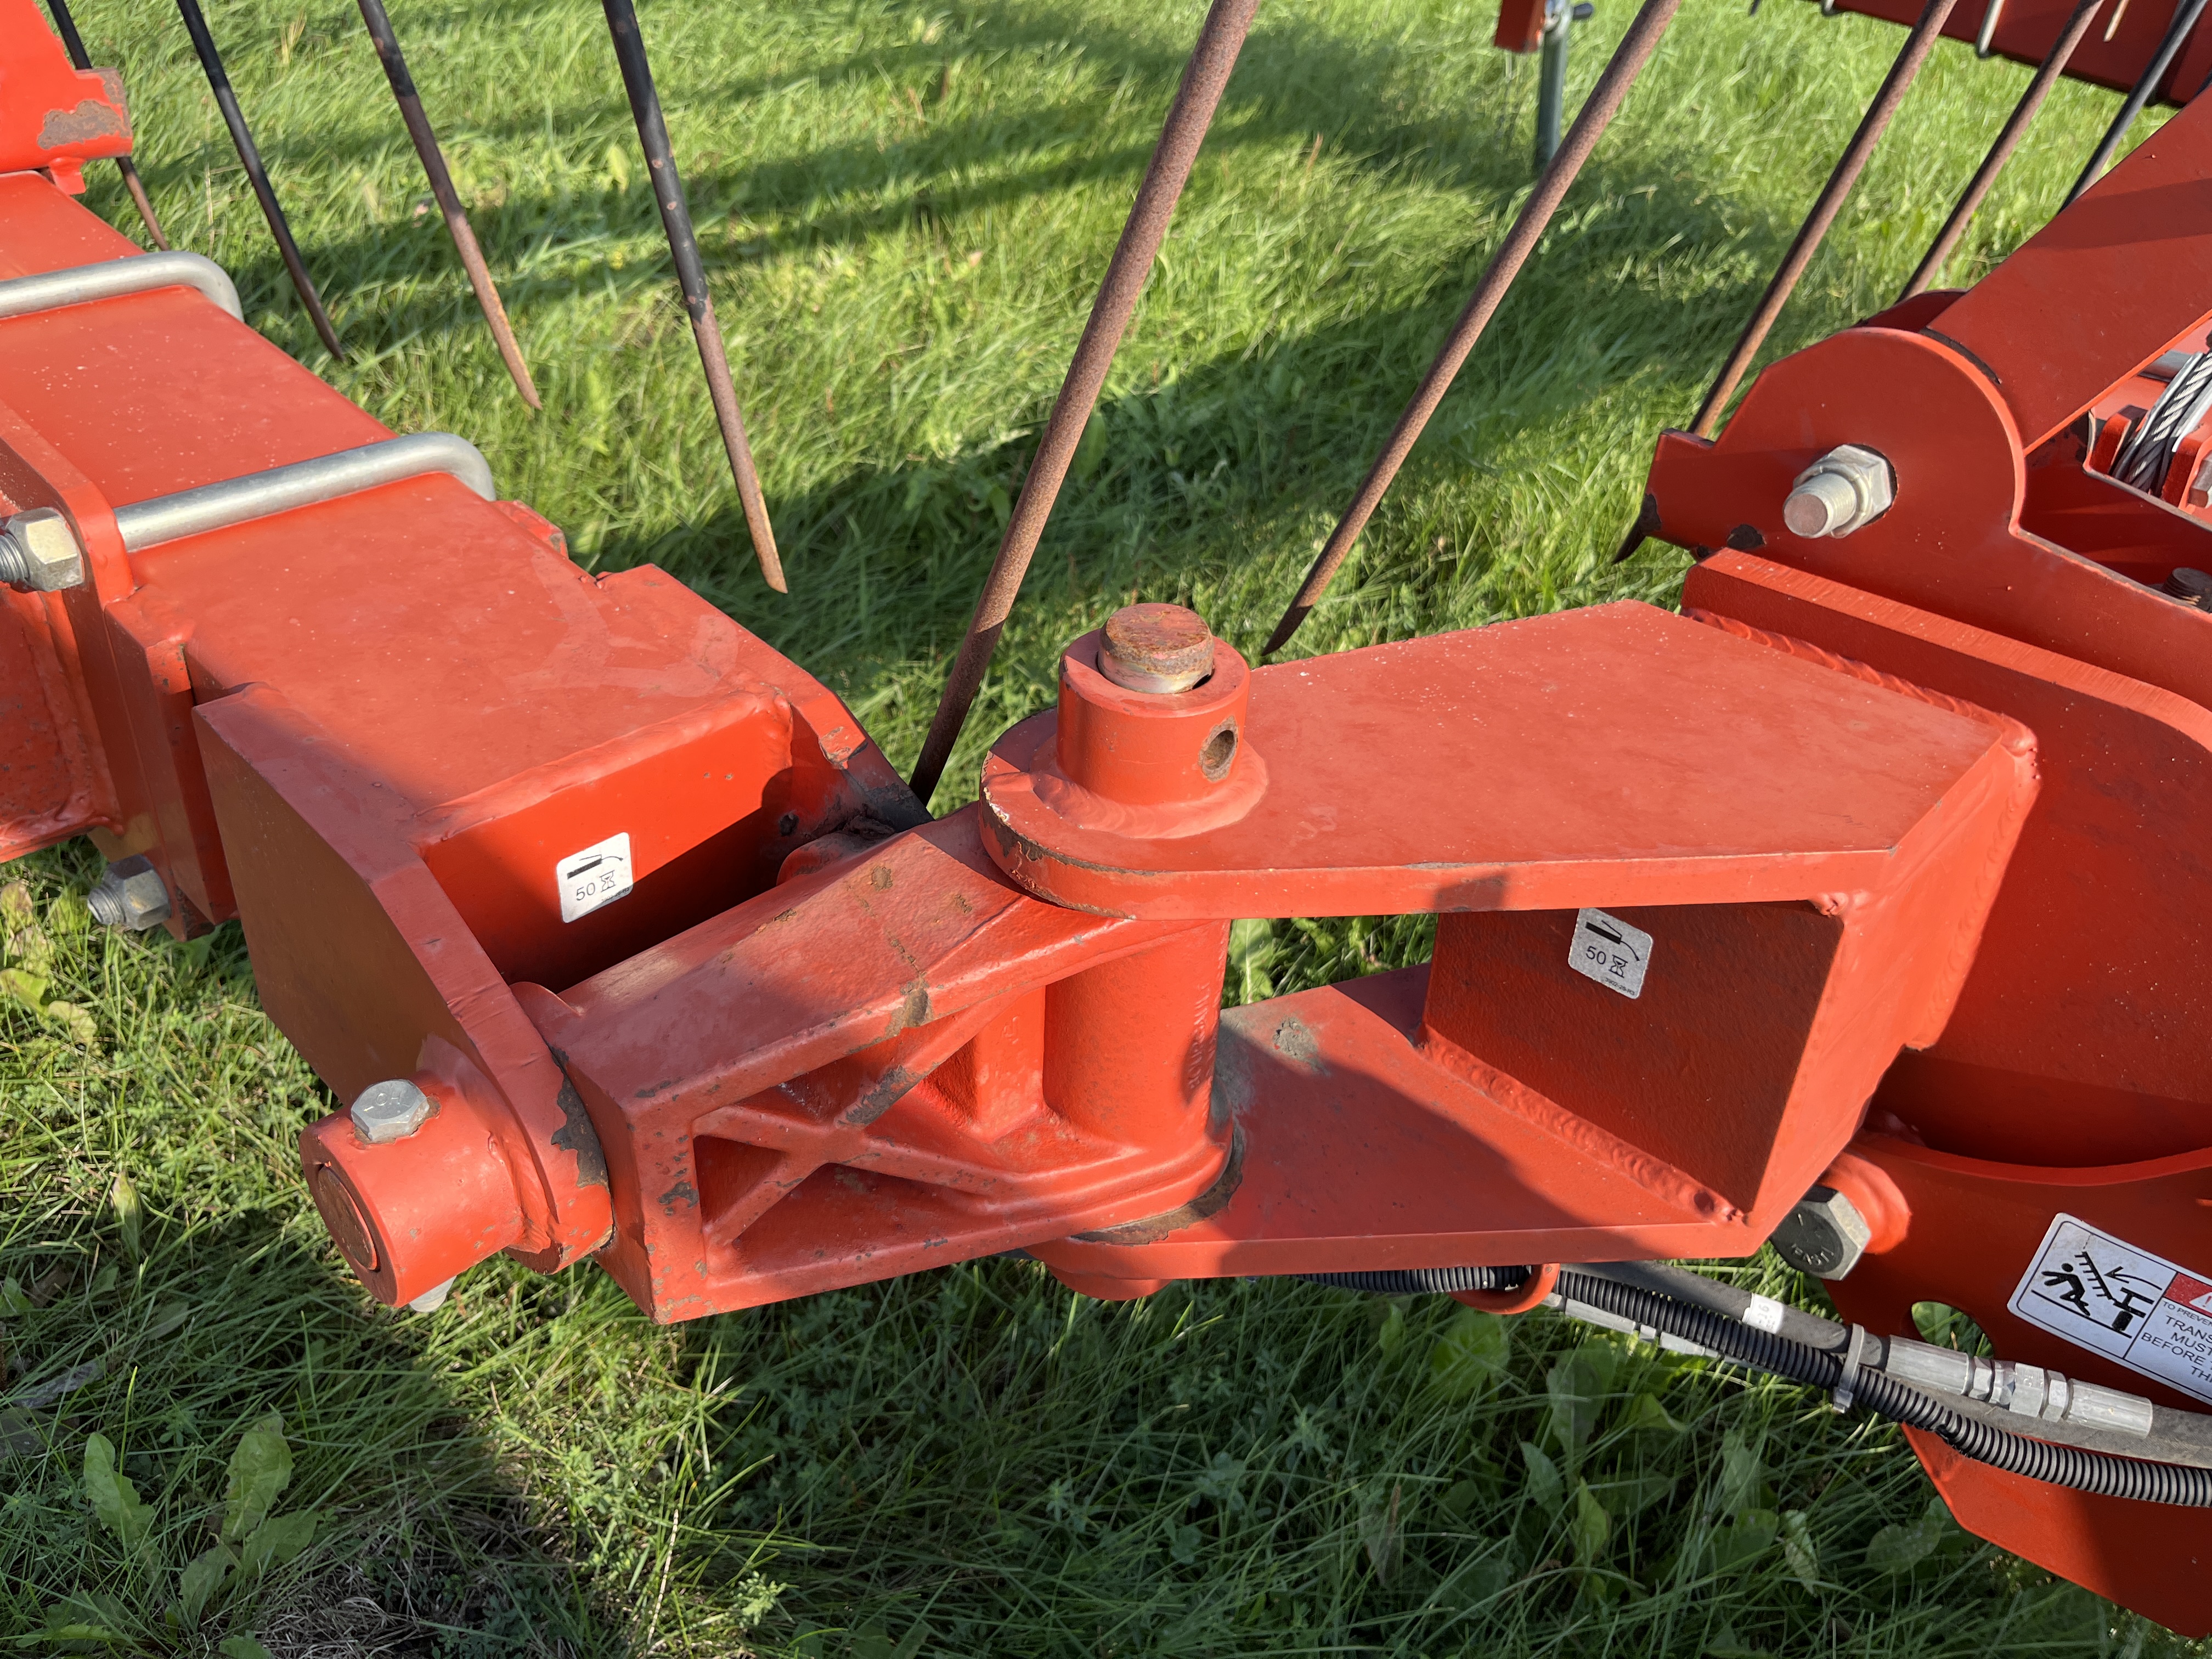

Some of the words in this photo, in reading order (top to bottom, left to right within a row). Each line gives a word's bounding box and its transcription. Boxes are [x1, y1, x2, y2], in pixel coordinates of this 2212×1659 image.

[576, 882, 595, 901] 50
[1585, 945, 1606, 964] 50
[2163, 1301, 2175, 1310] TO
[2141, 1332, 2206, 1366] BEFORE
